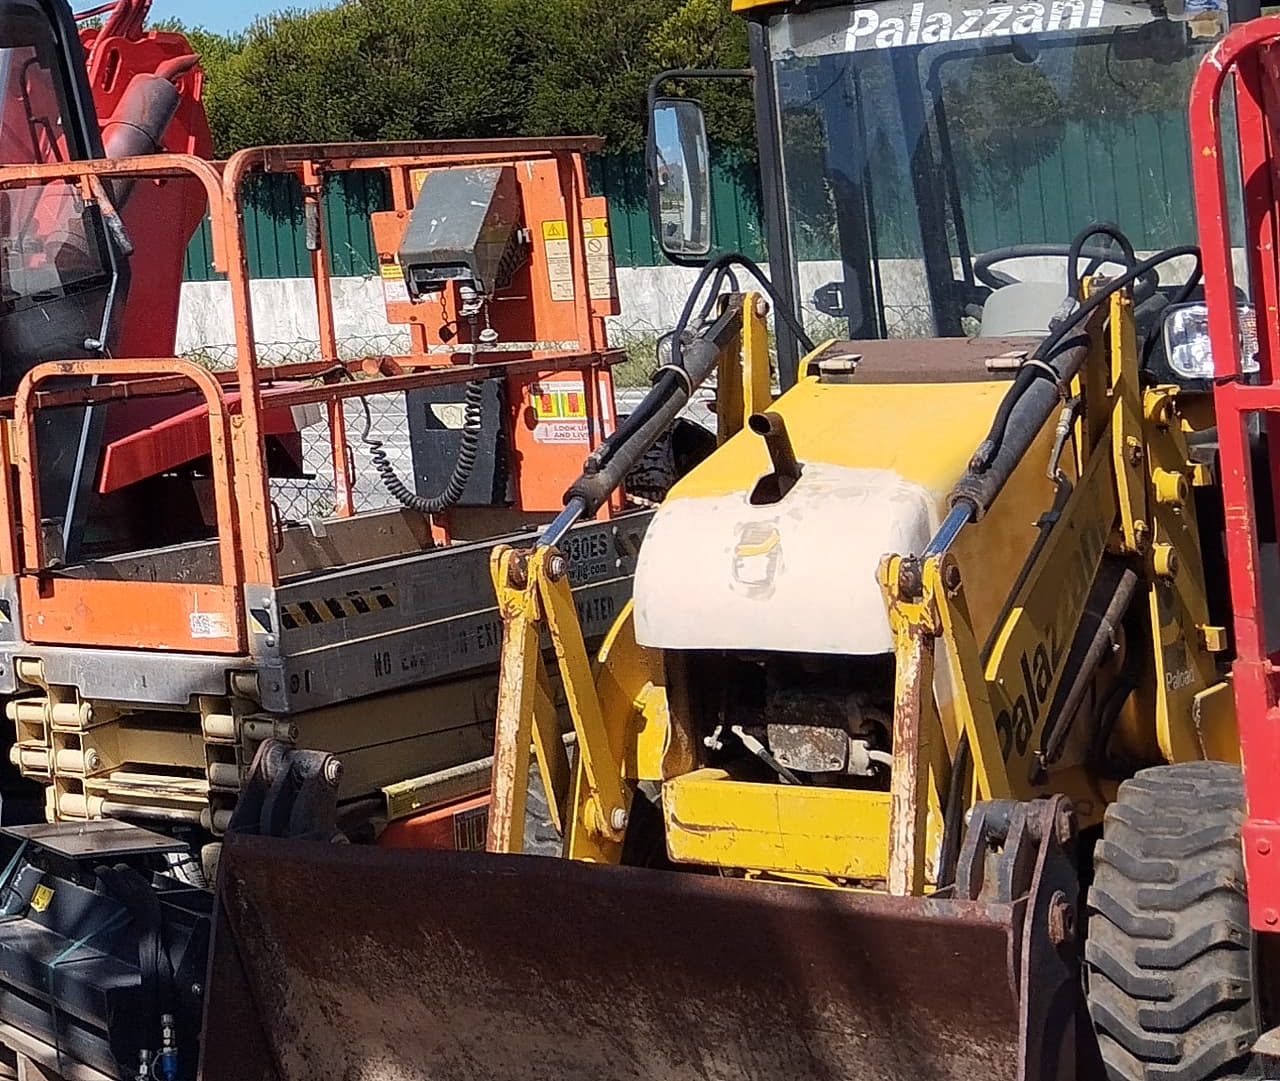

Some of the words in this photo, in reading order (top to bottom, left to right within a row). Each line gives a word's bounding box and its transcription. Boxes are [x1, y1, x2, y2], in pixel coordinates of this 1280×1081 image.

[553, 424, 575, 432] LOOK
[374, 651, 392, 678] NO
[476, 621, 500, 650] EXI
